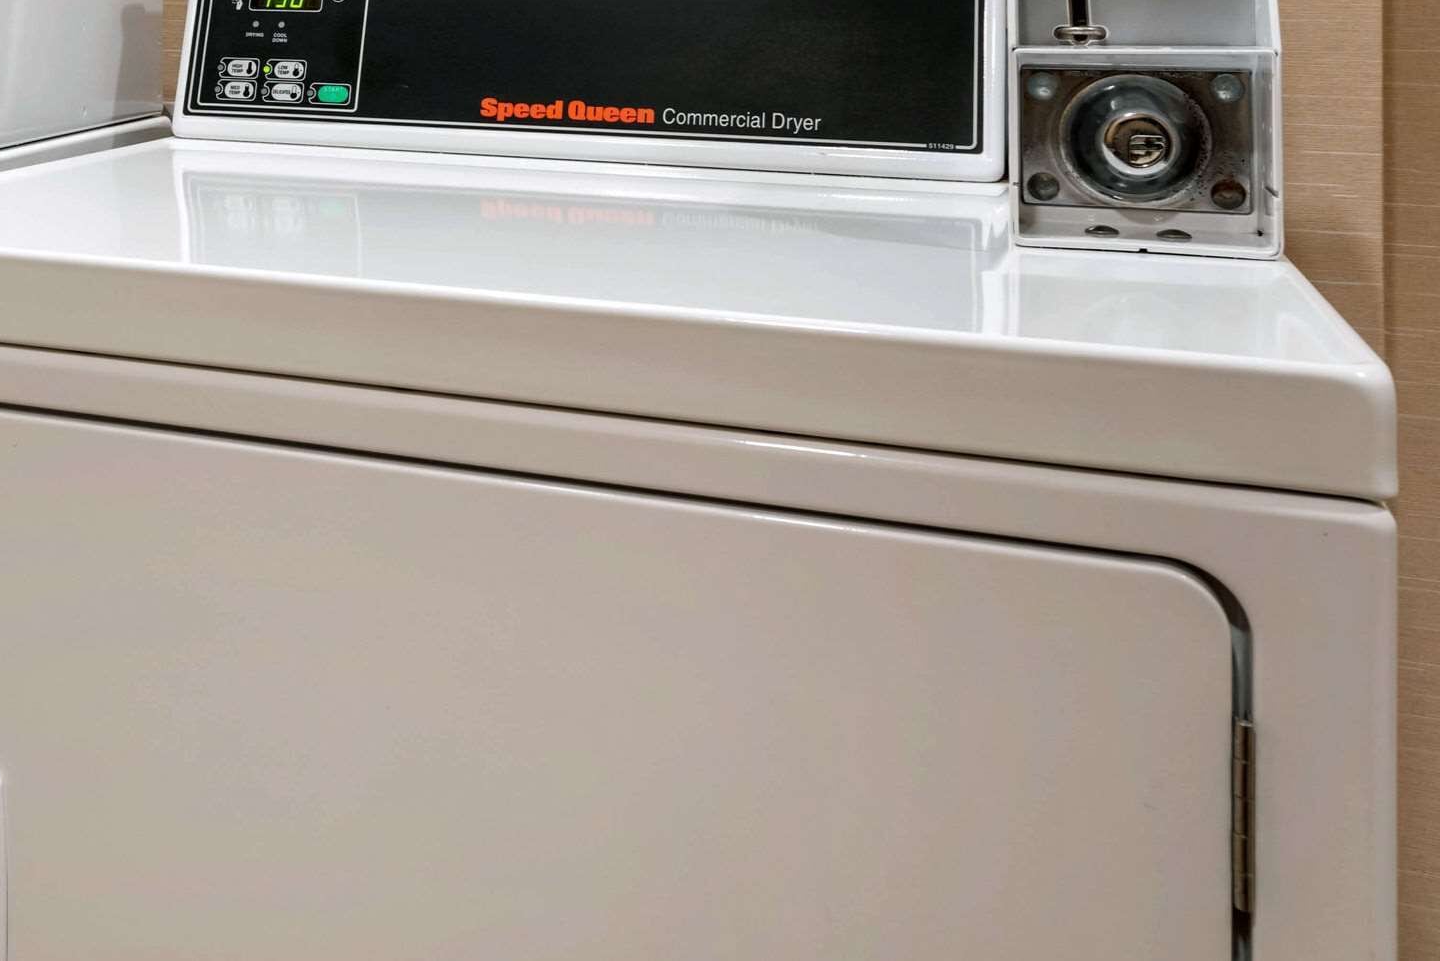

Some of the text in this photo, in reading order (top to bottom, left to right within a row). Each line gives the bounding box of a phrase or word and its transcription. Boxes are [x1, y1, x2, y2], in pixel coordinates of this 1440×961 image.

[480, 97, 822, 135] Speed Queen Commercial Dryer
